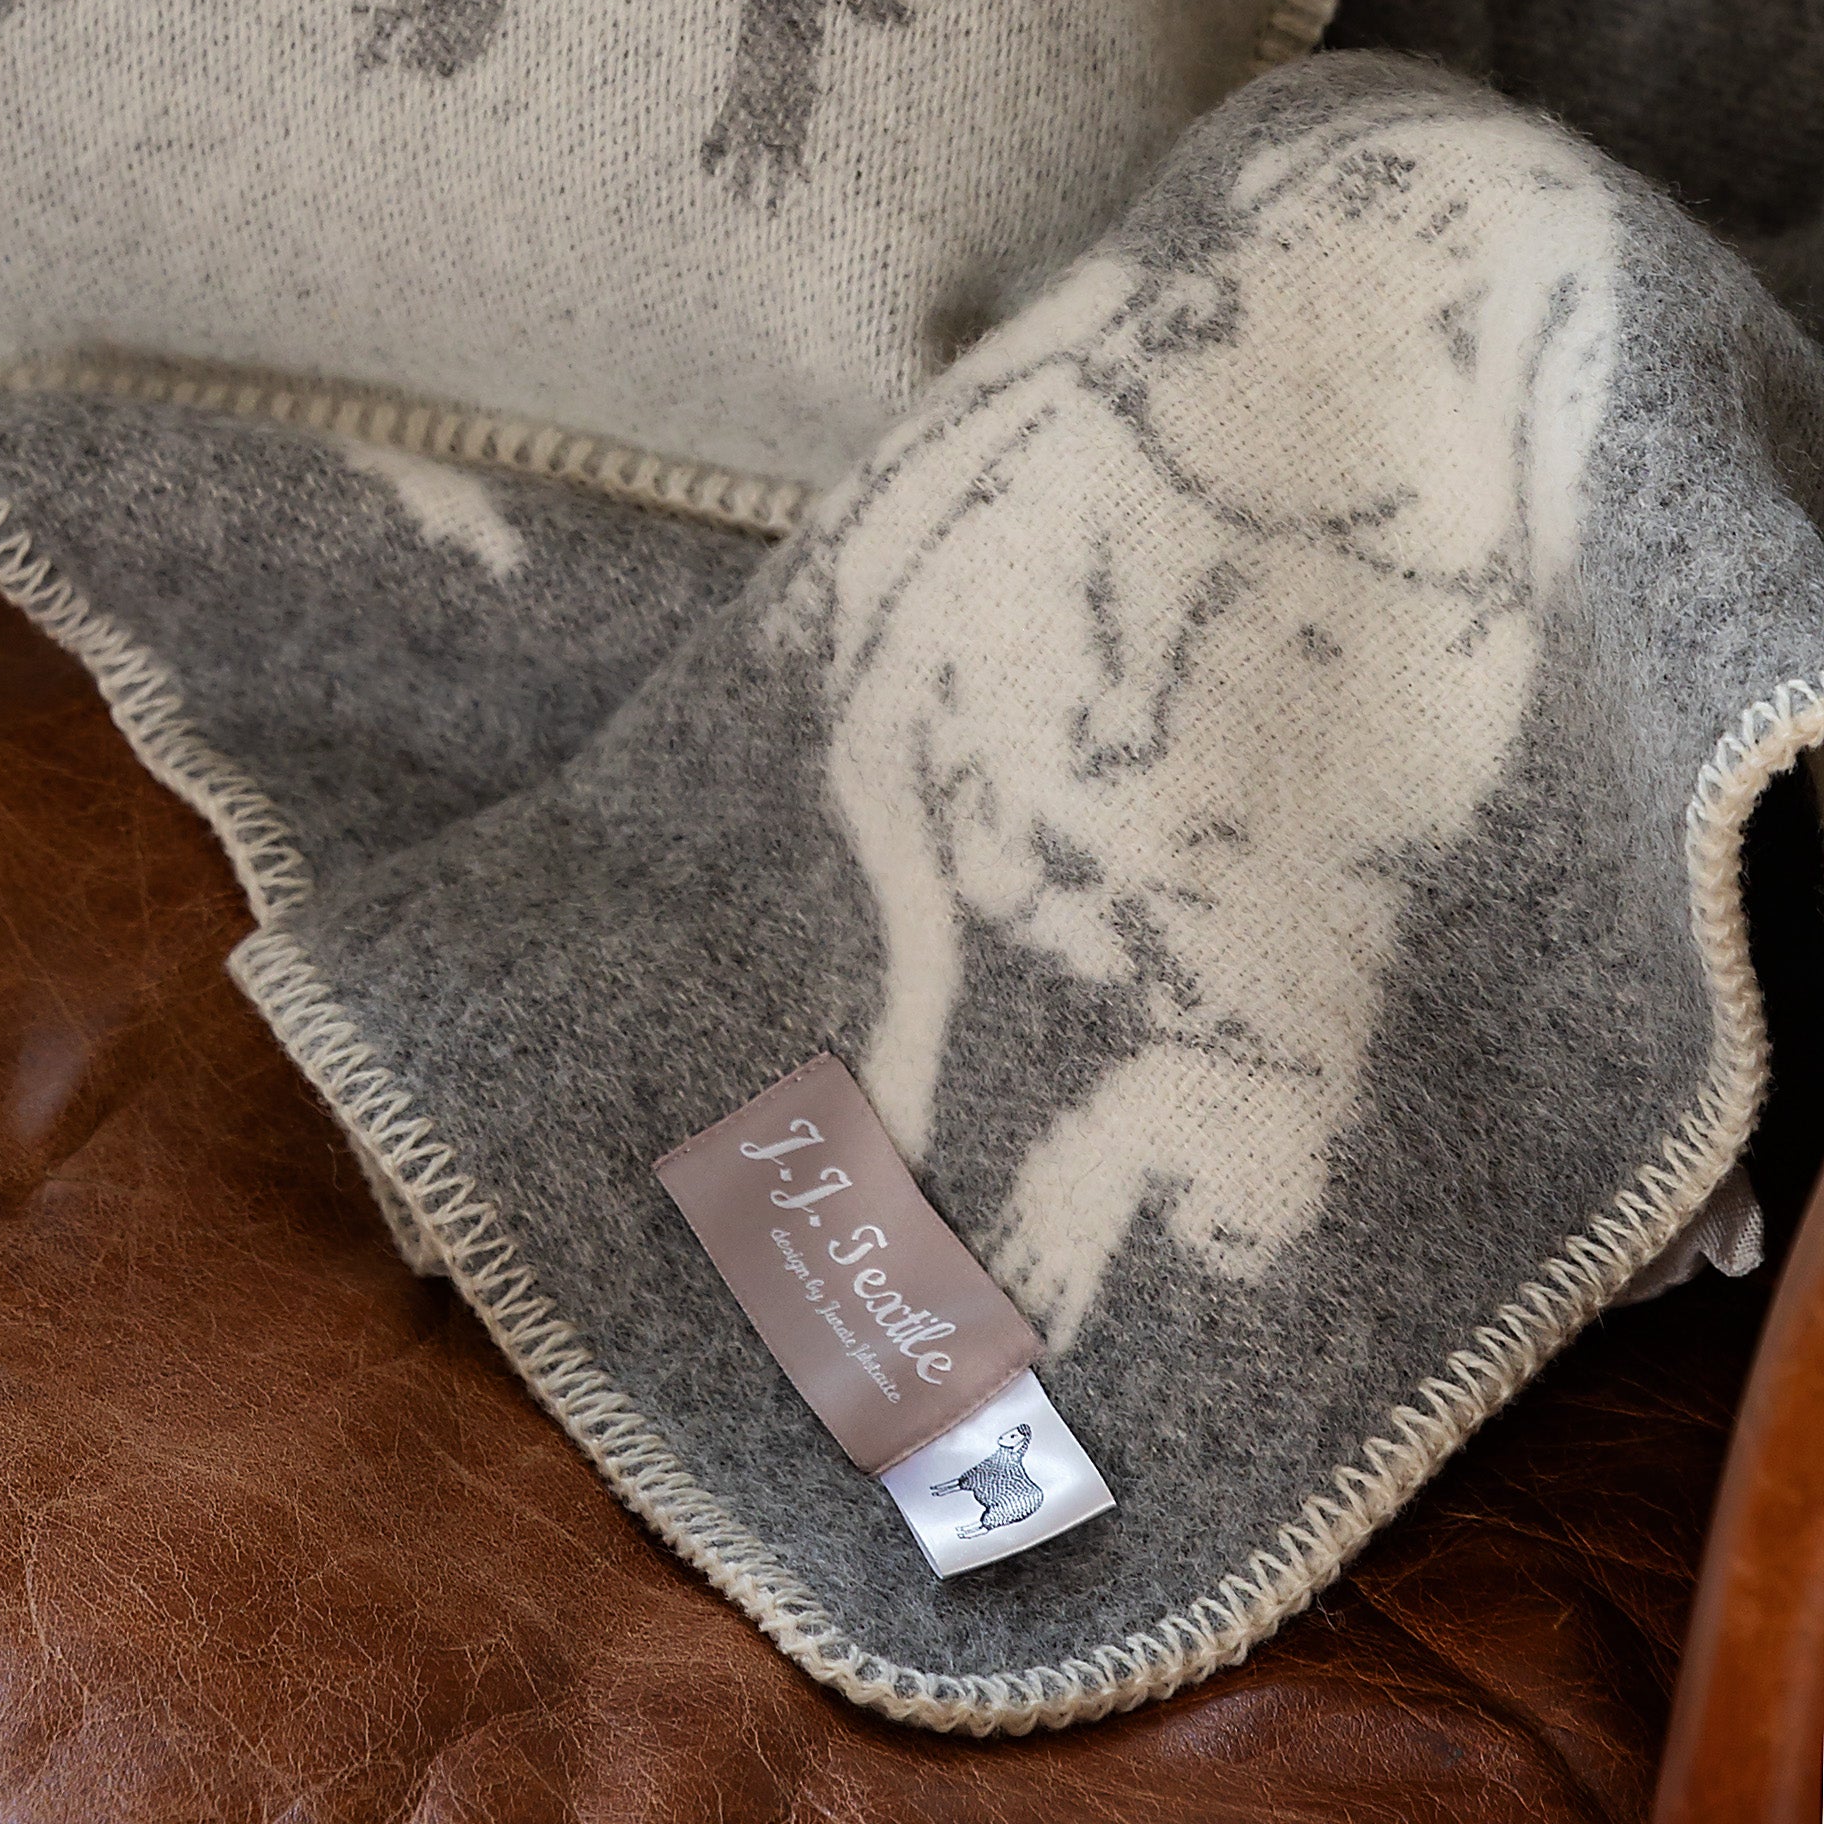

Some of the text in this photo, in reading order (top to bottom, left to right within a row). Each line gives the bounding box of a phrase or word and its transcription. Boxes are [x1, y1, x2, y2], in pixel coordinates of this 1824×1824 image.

[770, 1228, 810, 1280] design
[805, 1278, 825, 1302] by
[828, 1224, 956, 1386] Textile
